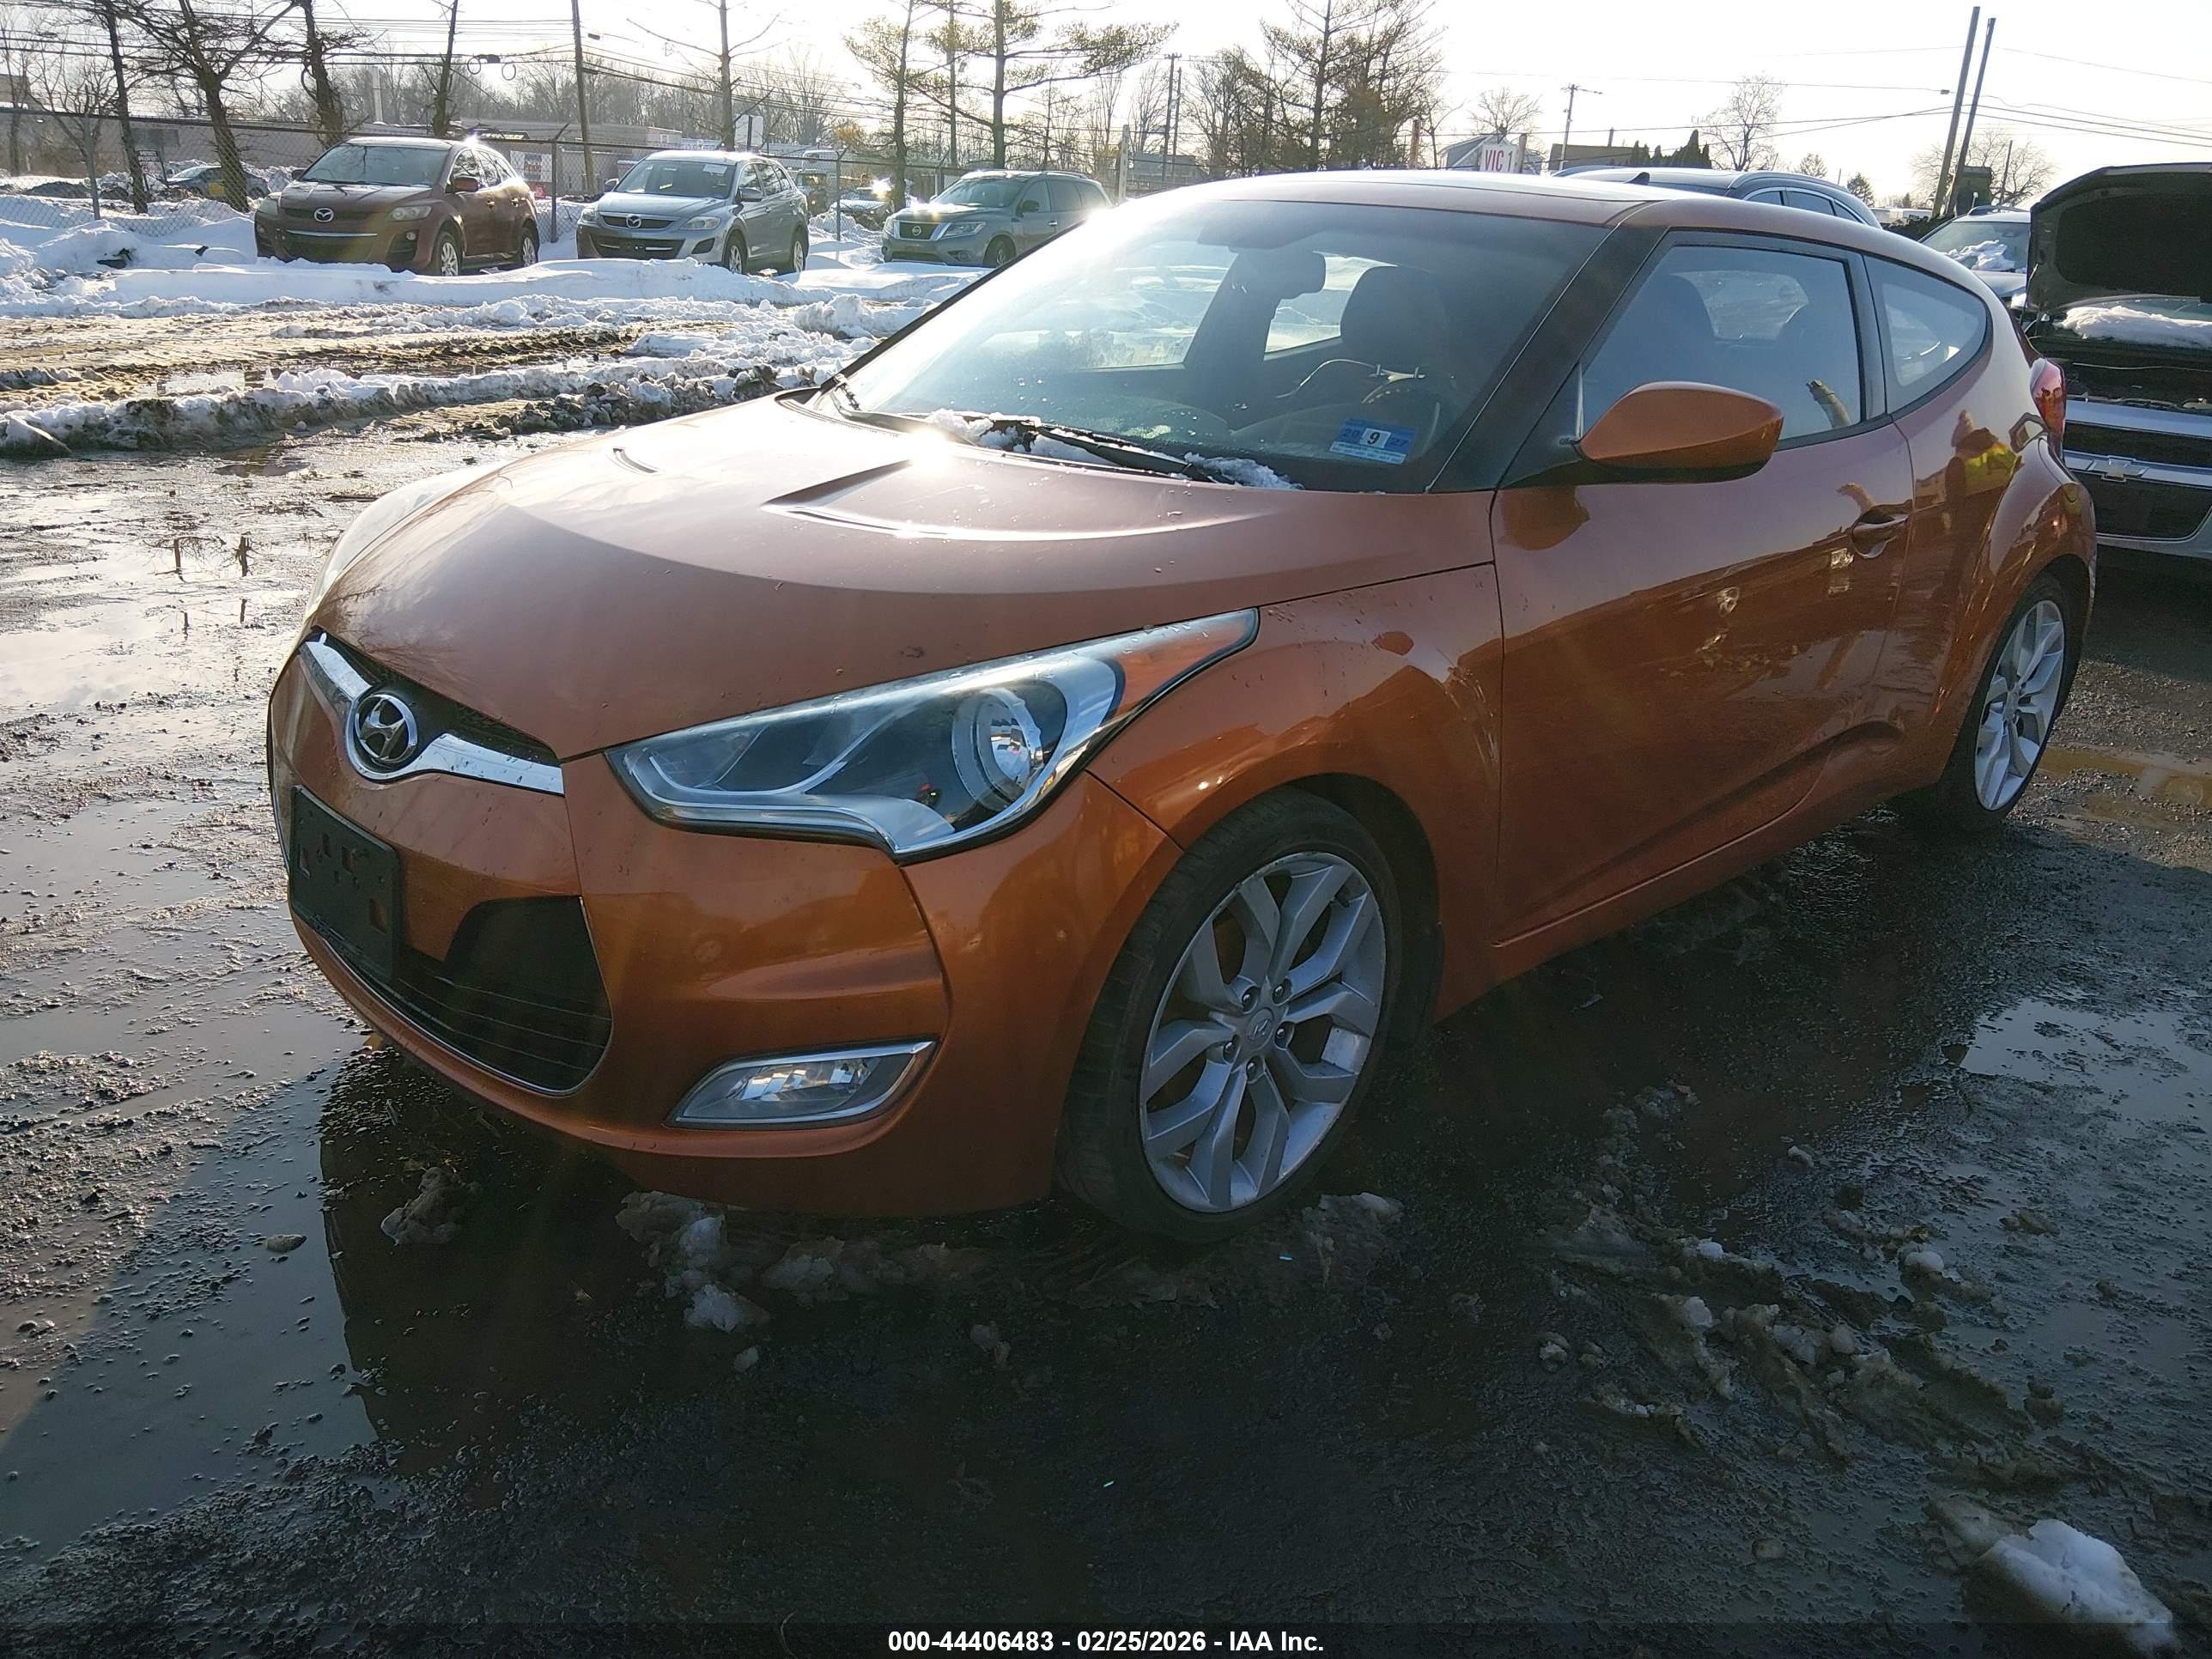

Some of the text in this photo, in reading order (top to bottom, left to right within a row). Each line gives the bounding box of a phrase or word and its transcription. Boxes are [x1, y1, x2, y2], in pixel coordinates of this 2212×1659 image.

[1486, 149, 1513, 172] VIC 1
[1367, 431, 1381, 445] 9
